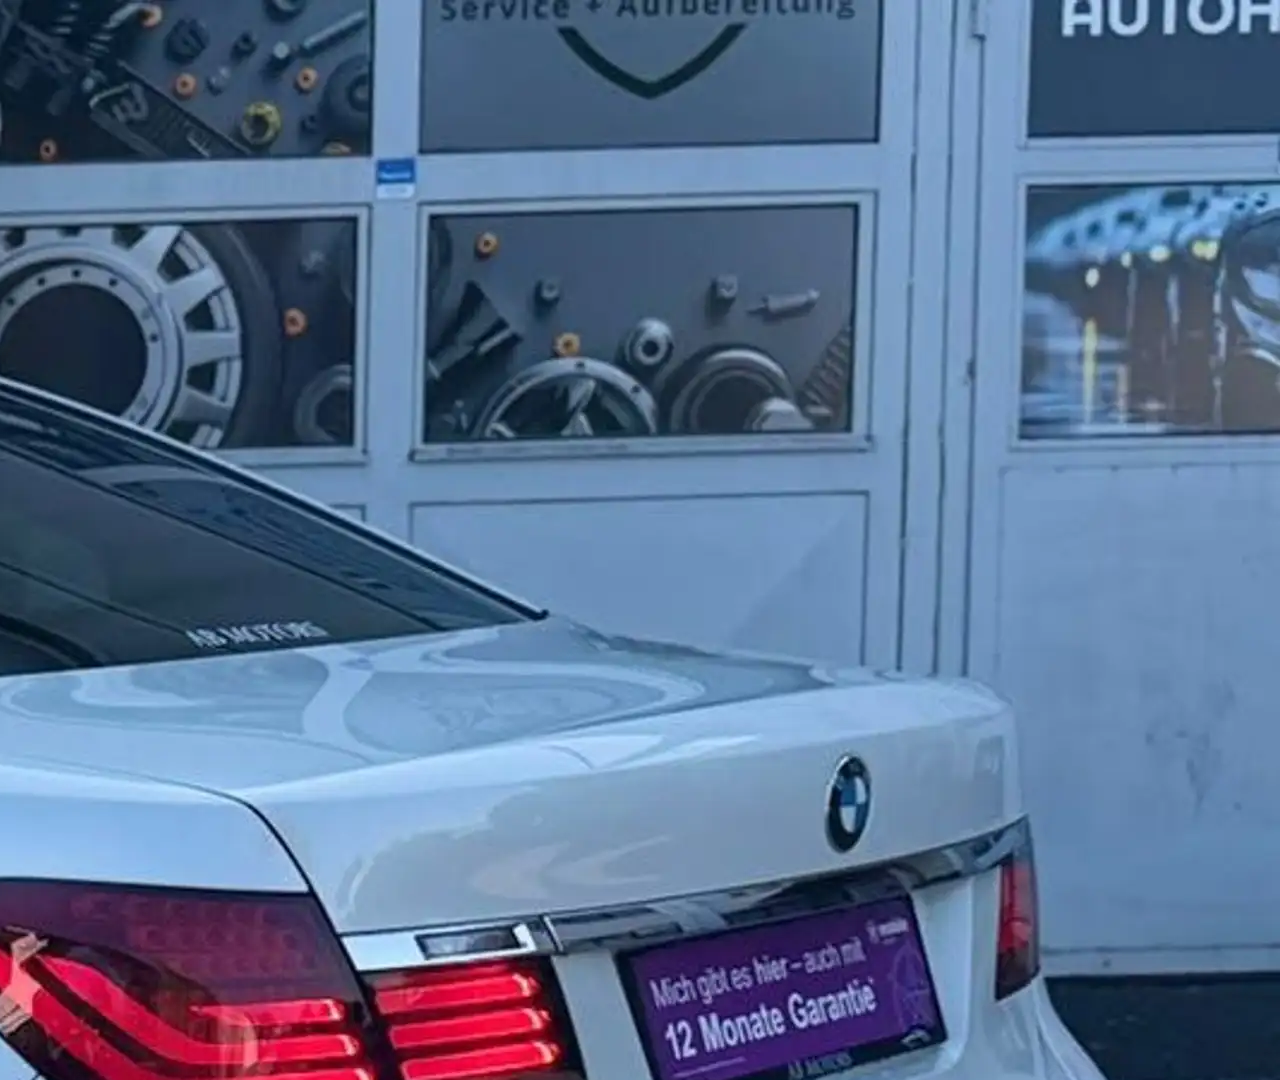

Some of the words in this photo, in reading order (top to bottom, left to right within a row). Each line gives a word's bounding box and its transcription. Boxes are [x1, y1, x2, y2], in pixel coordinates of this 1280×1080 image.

[441, 0, 571, 21] Service
[185, 627, 228, 649] AB
[217, 620, 330, 644] MOTORS
[649, 972, 696, 1009] Mich
[696, 966, 731, 1005] gibt
[730, 966, 754, 990] es
[752, 954, 789, 985] hier
[802, 941, 842, 974] auch
[841, 935, 867, 965] mit
[664, 1018, 698, 1061] 12
[697, 1002, 787, 1053] Monate
